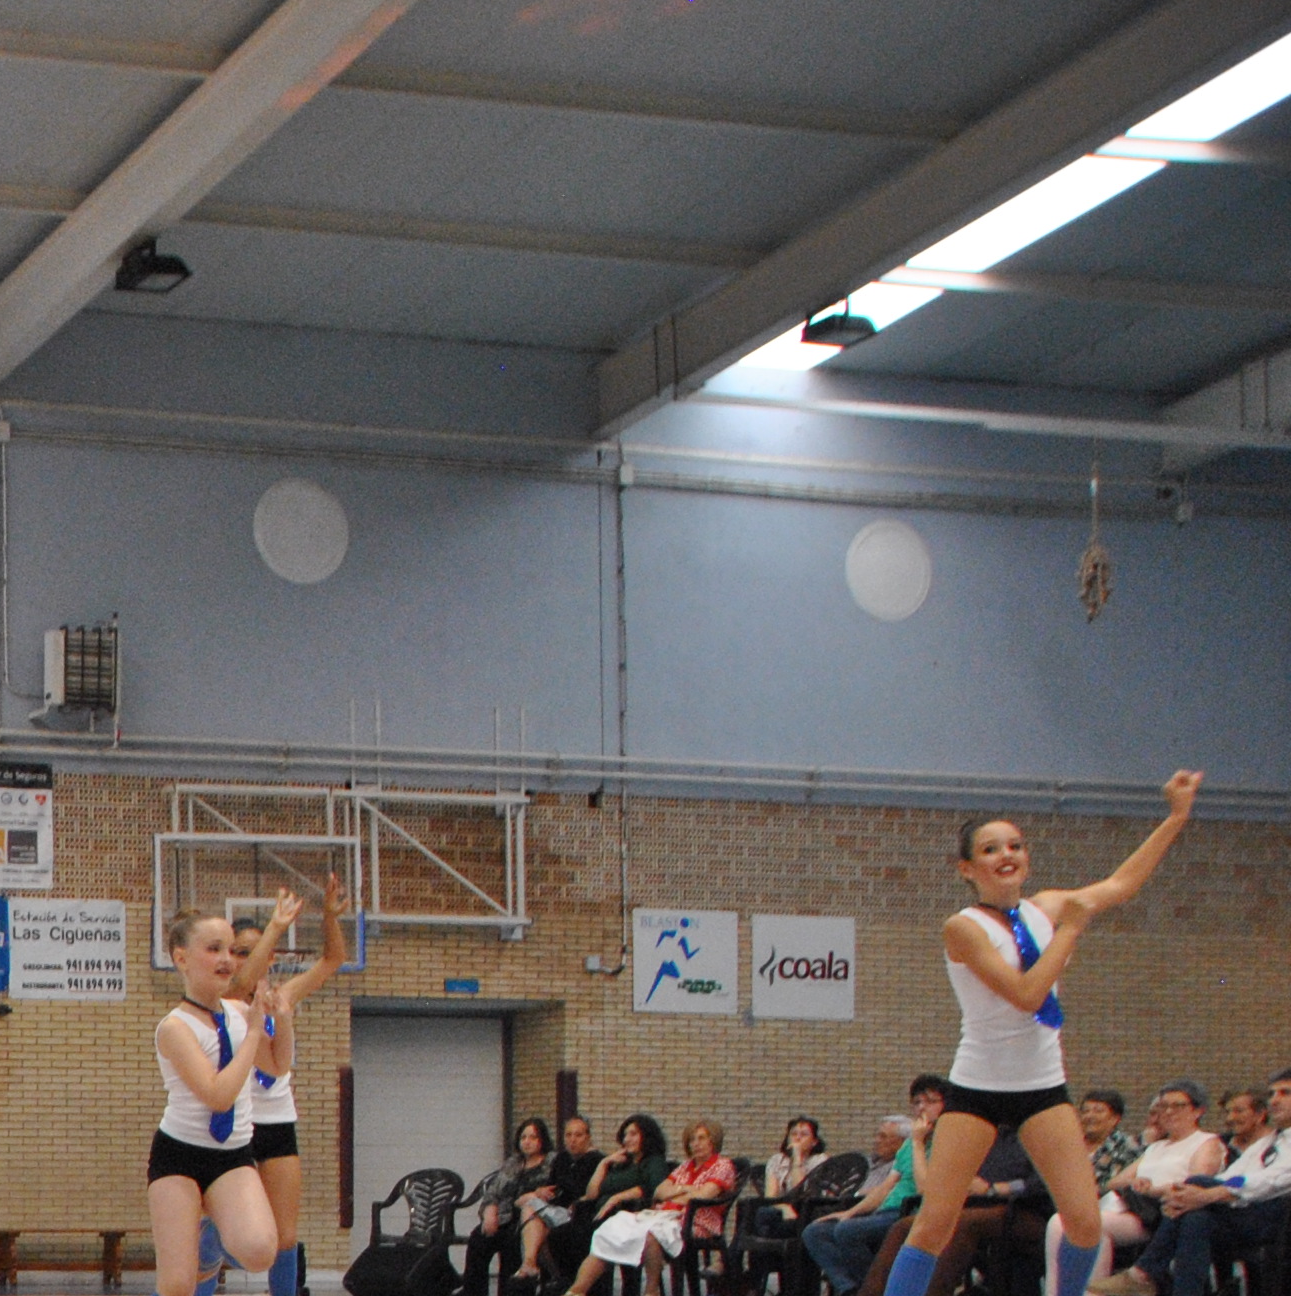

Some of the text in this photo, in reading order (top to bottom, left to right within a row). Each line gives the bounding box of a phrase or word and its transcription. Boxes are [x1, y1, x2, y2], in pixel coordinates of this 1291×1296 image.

[3, 770, 13, 779] de
[12, 925, 41, 941] Las
[65, 958, 82, 971] 941
[84, 958, 101, 971] 894
[104, 958, 122, 971] 994
[778, 949, 849, 980] coala
[67, 977, 84, 990] 941
[86, 977, 103, 991] 894
